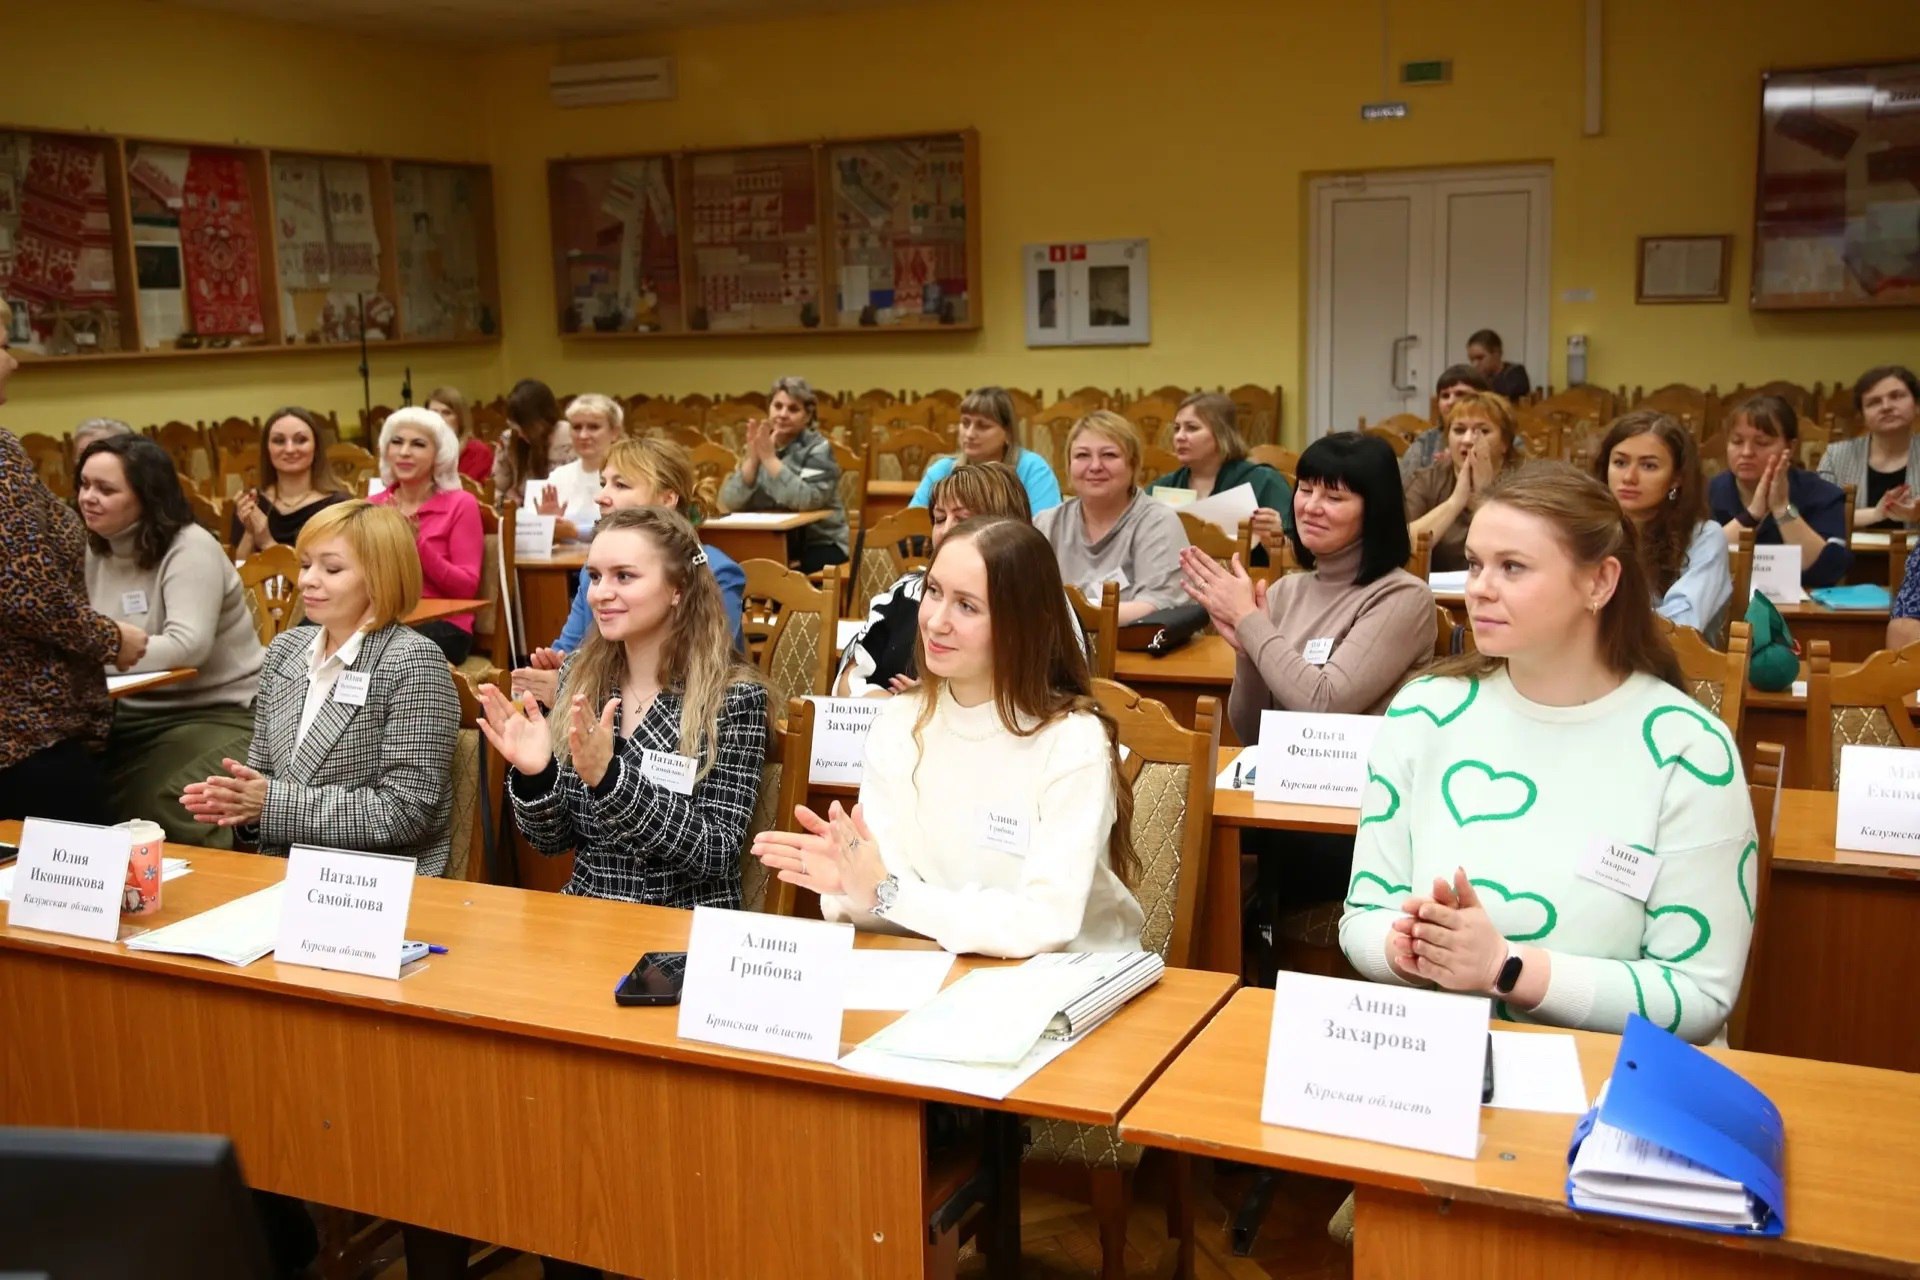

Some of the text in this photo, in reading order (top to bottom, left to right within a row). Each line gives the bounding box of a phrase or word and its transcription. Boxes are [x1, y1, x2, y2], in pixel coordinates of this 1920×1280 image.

[824, 702, 878, 715] Людмил
[826, 719, 871, 734] Захаро
[1302, 727, 1345, 741] Ольга
[815, 757, 849, 768] Курская
[1280, 779, 1359, 793] Курская область
[52, 847, 90, 866] Юлия
[1605, 844, 1640, 865] Анна
[319, 866, 379, 889] Наталья
[1600, 856, 1637, 877] Захарова
[30, 866, 105, 891] Иконникова
[23, 893, 105, 915] Калужская область
[307, 888, 384, 913] Самойлова
[301, 938, 377, 960] Курская область
[741, 932, 798, 954] Алина
[729, 955, 803, 983] Грибова
[1347, 992, 1407, 1018] Анна
[705, 1013, 814, 1042] Брянская область
[1322, 1017, 1428, 1053] Захарова
[1303, 1081, 1434, 1117] Курская область
